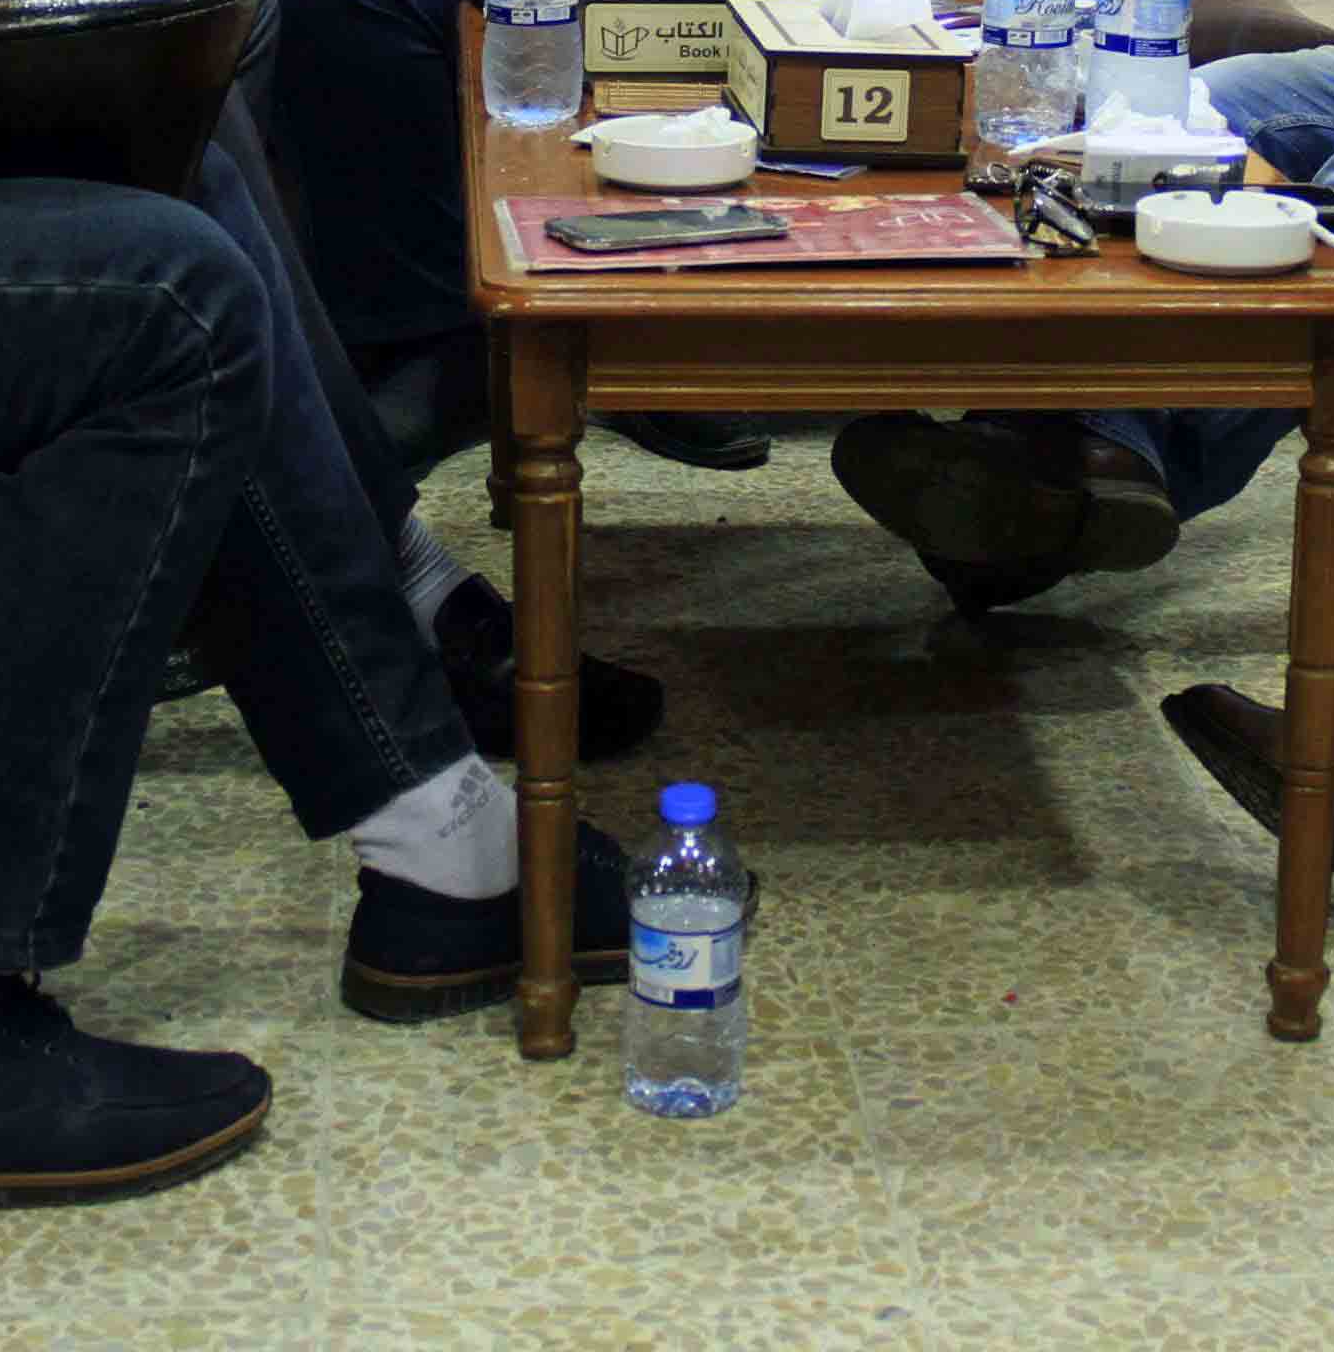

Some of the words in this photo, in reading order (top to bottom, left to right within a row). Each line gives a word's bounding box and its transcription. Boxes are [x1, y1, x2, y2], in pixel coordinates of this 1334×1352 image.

[655, 20, 723, 43] الكتاب
[679, 45, 722, 59] Book
[835, 85, 893, 124] 12
